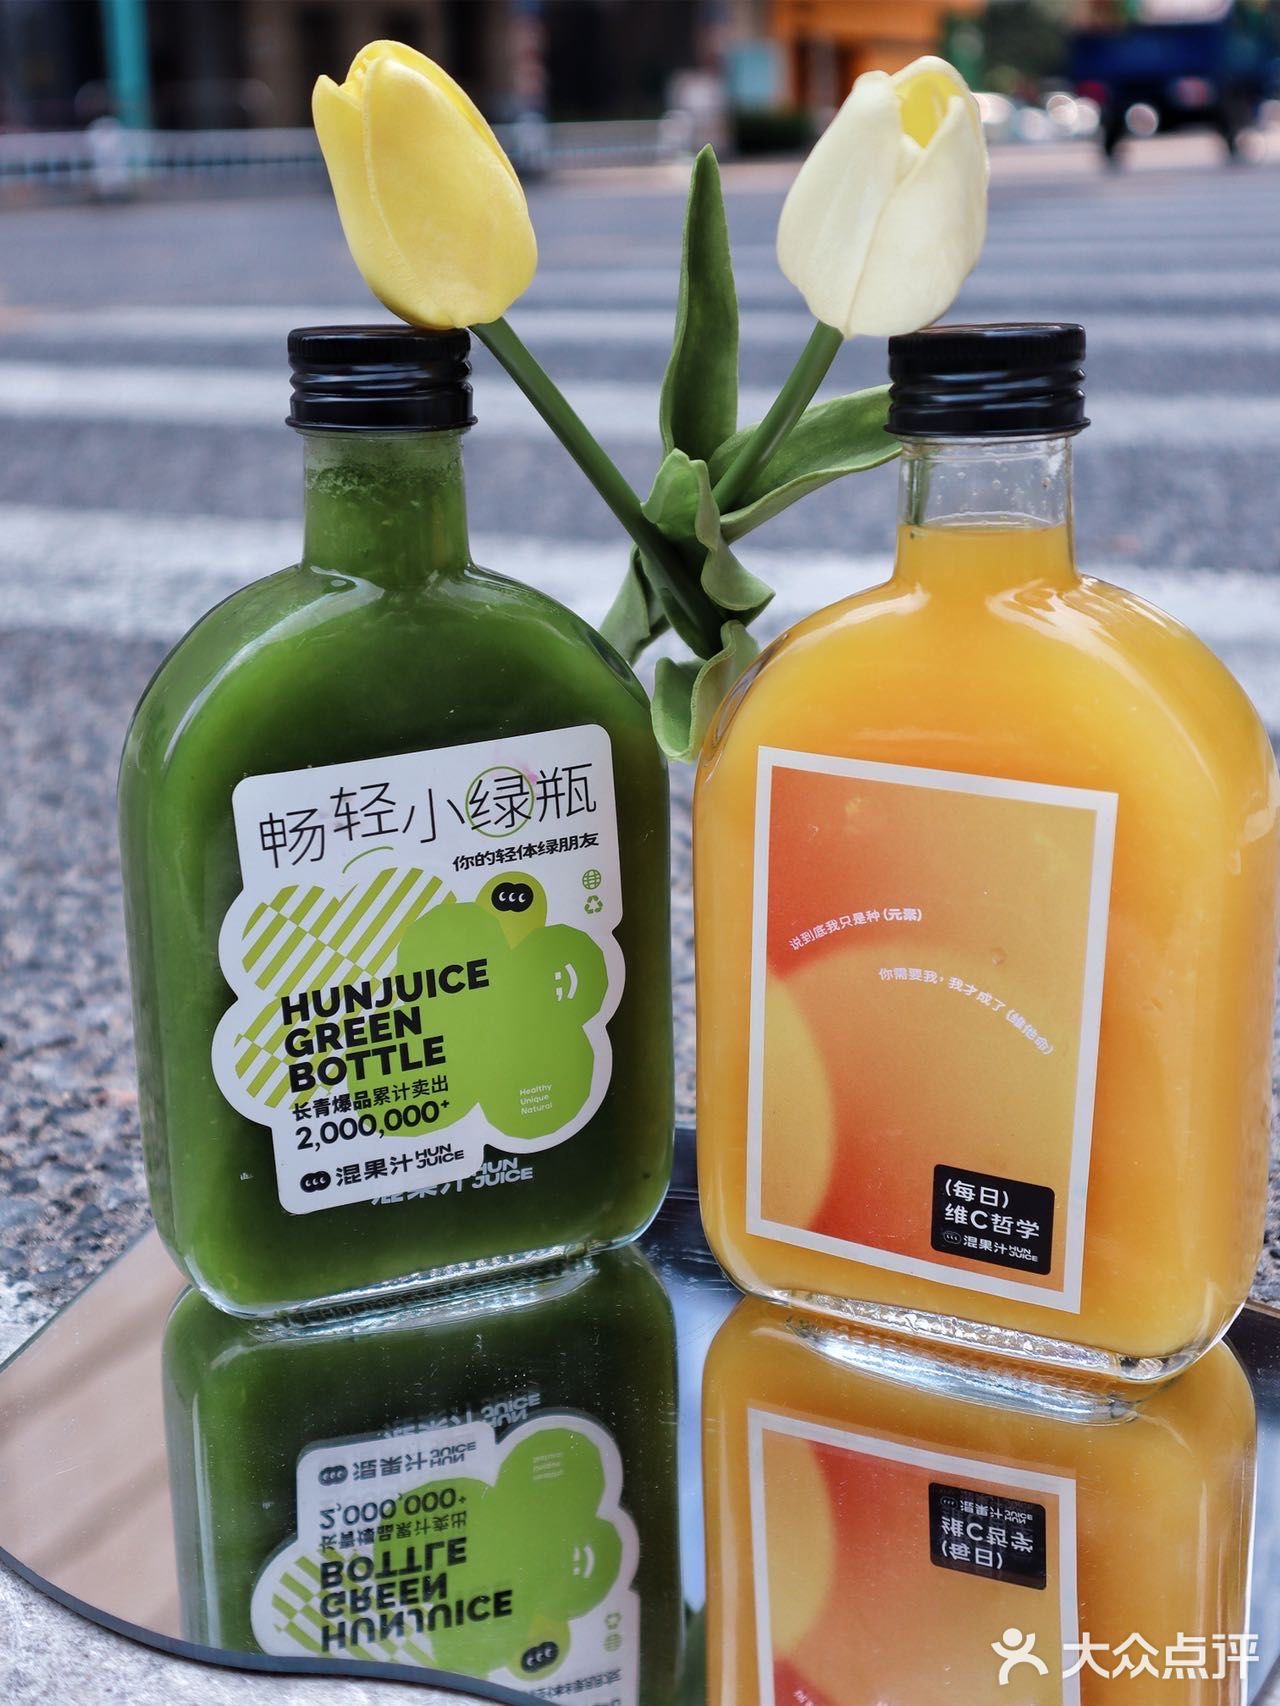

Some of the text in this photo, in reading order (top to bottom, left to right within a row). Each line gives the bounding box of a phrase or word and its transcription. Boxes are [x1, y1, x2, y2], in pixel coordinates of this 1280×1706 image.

[259, 763, 597, 868] 畅轻小绿瓶
[452, 832, 599, 871] 你的轻体绿朋友
[281, 958, 489, 1025] HUNJUICE
[284, 1006, 422, 1058] GREEN
[288, 1035, 446, 1093] BOTTLE
[292, 1075, 449, 1121] 长青爆品累计卖出
[520, 1084, 552, 1096] Healthy
[520, 1094, 549, 1105] Unique
[521, 1102, 552, 1115] Natural
[295, 1100, 449, 1152] 2,000,000+
[415, 1143, 451, 1160] HUN
[416, 1150, 464, 1169] JUICE
[472, 1167, 533, 1189] JUICE
[945, 1178, 1009, 1209] (每日)
[945, 1203, 1039, 1240] 维C哲学
[1008, 1245, 1031, 1255] HUN
[1009, 1251, 1038, 1262] JUICE
